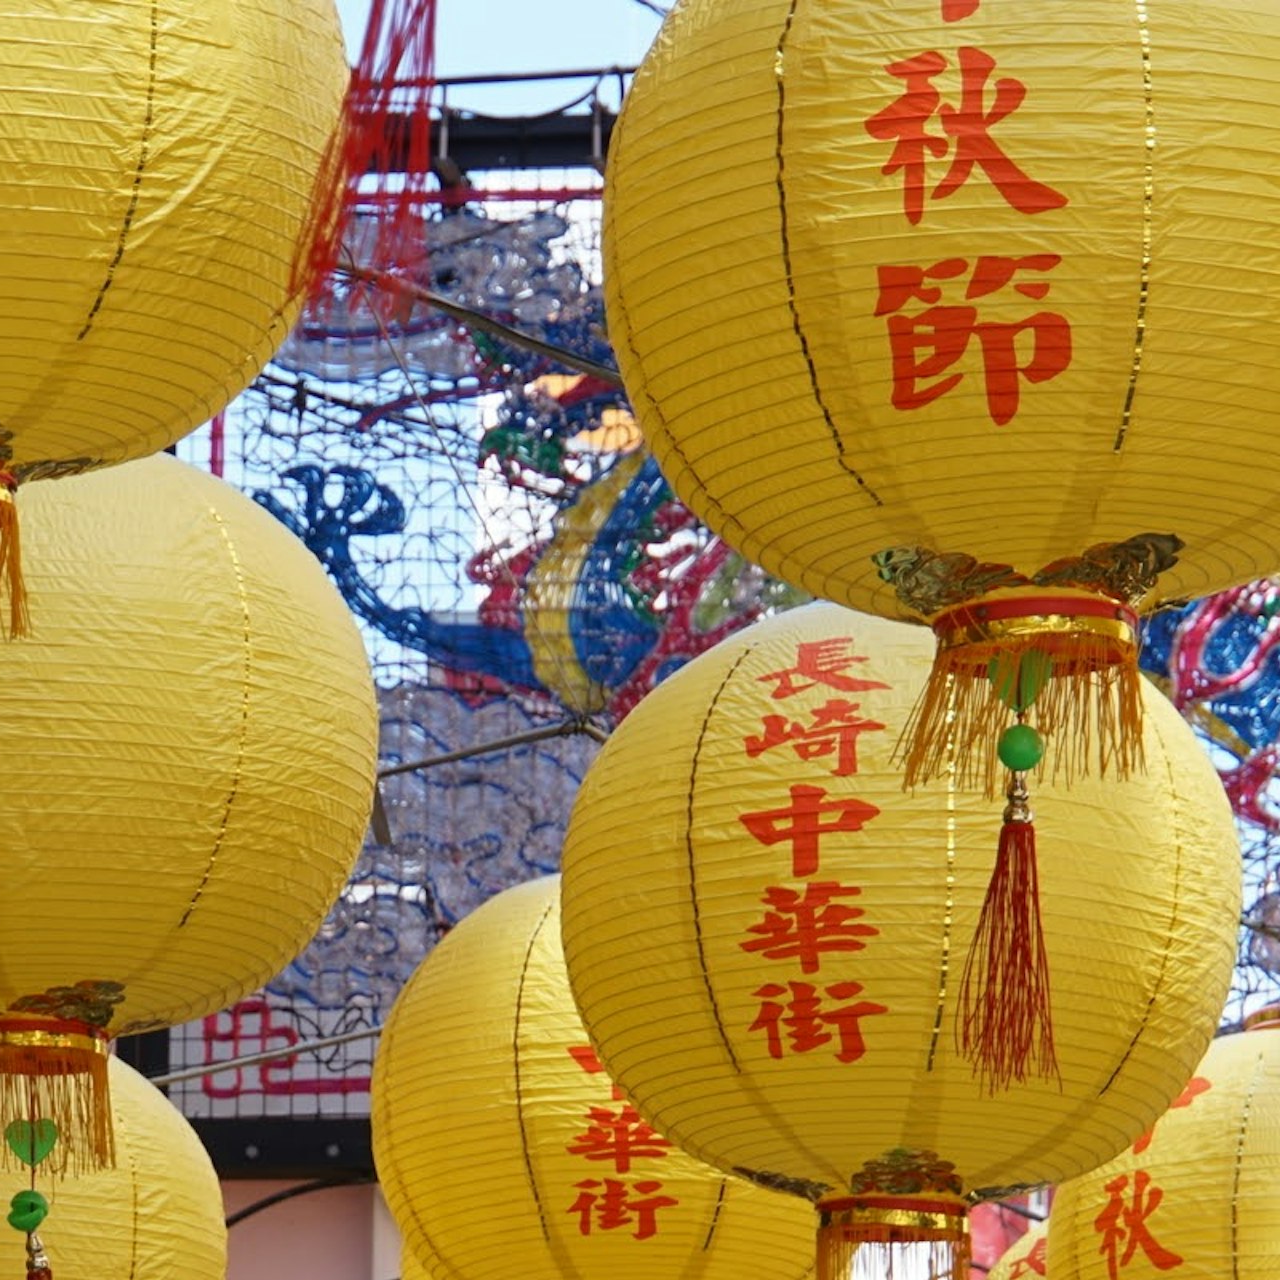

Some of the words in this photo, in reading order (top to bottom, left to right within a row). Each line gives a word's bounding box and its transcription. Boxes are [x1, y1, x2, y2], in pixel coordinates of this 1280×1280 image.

[738, 637, 890, 1064] 長崎中華街
